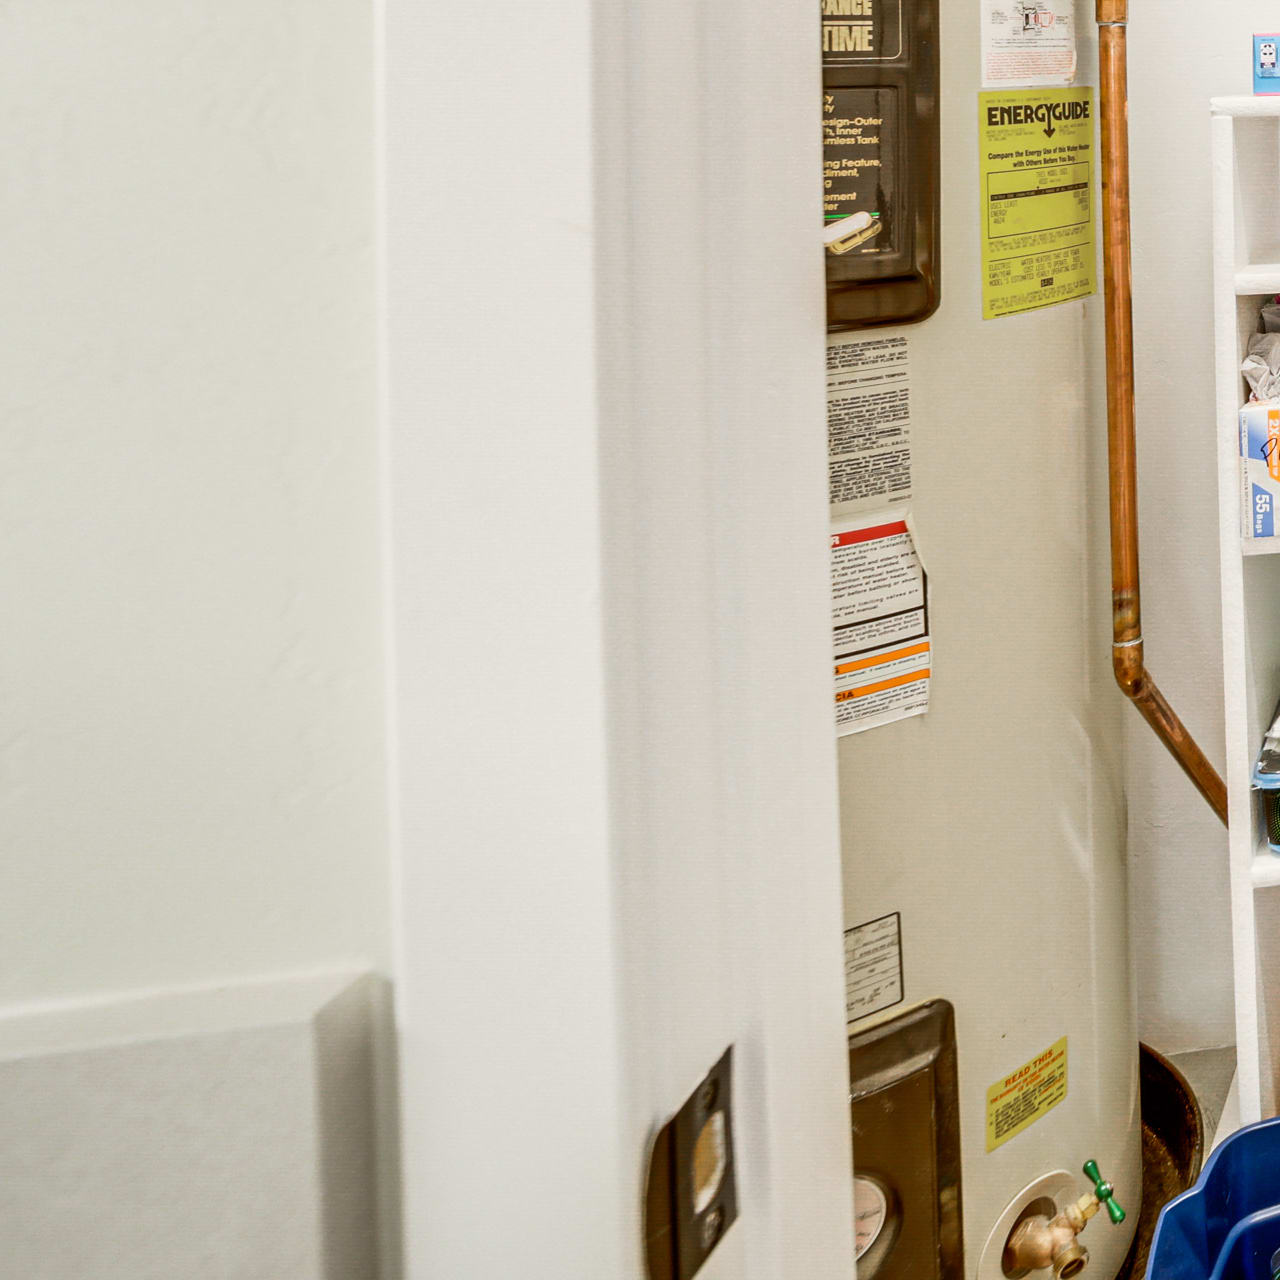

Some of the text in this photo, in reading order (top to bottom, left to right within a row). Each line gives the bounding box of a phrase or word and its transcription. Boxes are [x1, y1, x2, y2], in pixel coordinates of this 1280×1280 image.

[987, 100, 1090, 127] ENERGYGUIDE
[857, 136, 879, 144] Tank
[988, 151, 1014, 160] Compare
[1025, 149, 1042, 158] Energy
[1256, 494, 1270, 533] 55 Bags
[1005, 1048, 1054, 1087] READ THIS
